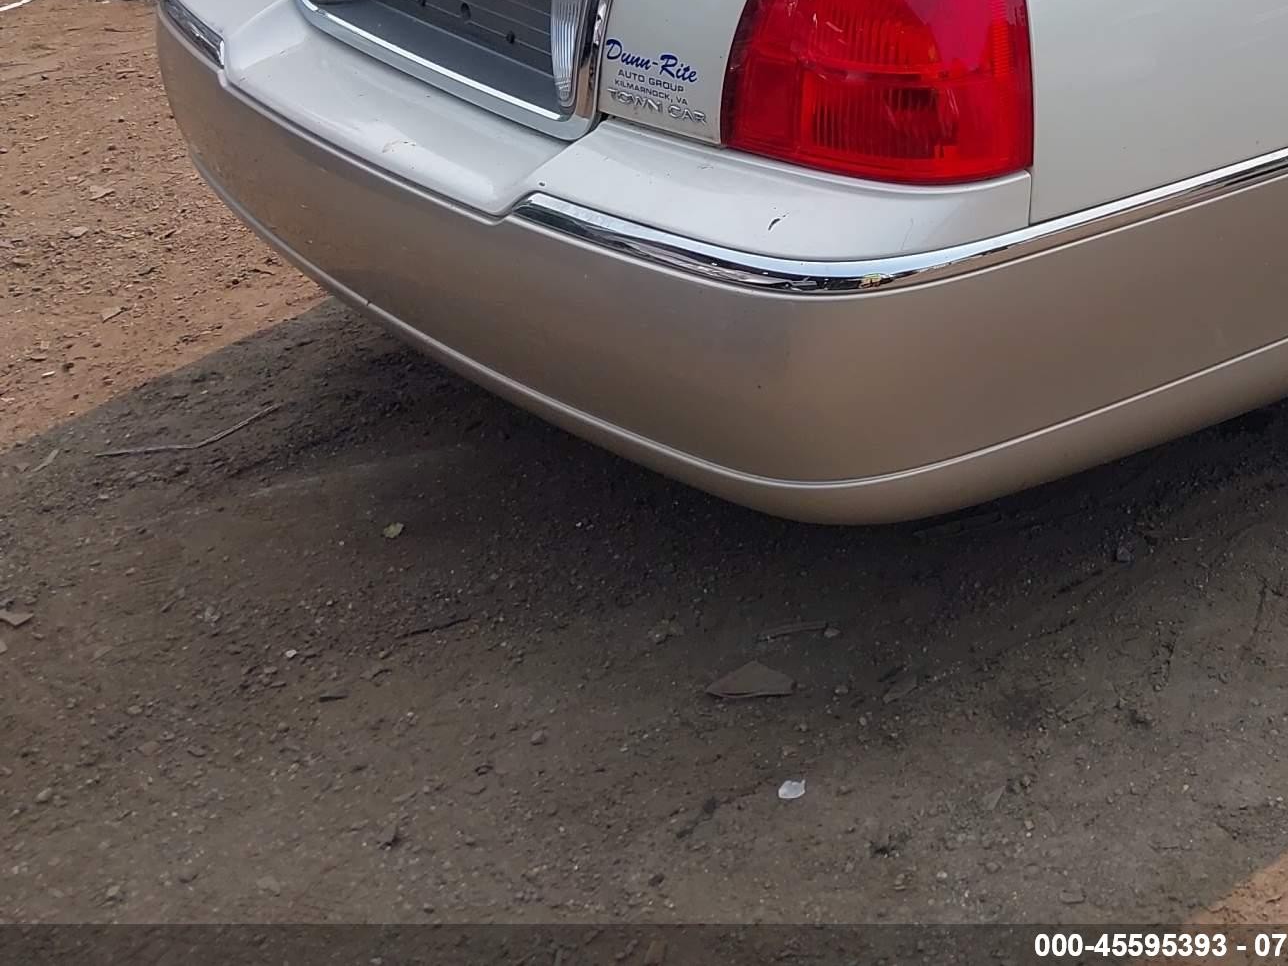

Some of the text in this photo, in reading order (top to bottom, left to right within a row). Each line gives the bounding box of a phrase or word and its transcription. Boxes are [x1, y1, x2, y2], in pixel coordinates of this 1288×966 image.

[605, 38, 698, 83] Dunn-Rite
[614, 79, 688, 106] KILMARNOCK, VA
[617, 68, 685, 93] AUTO GROUP
[607, 88, 708, 126] TOWN CAR
